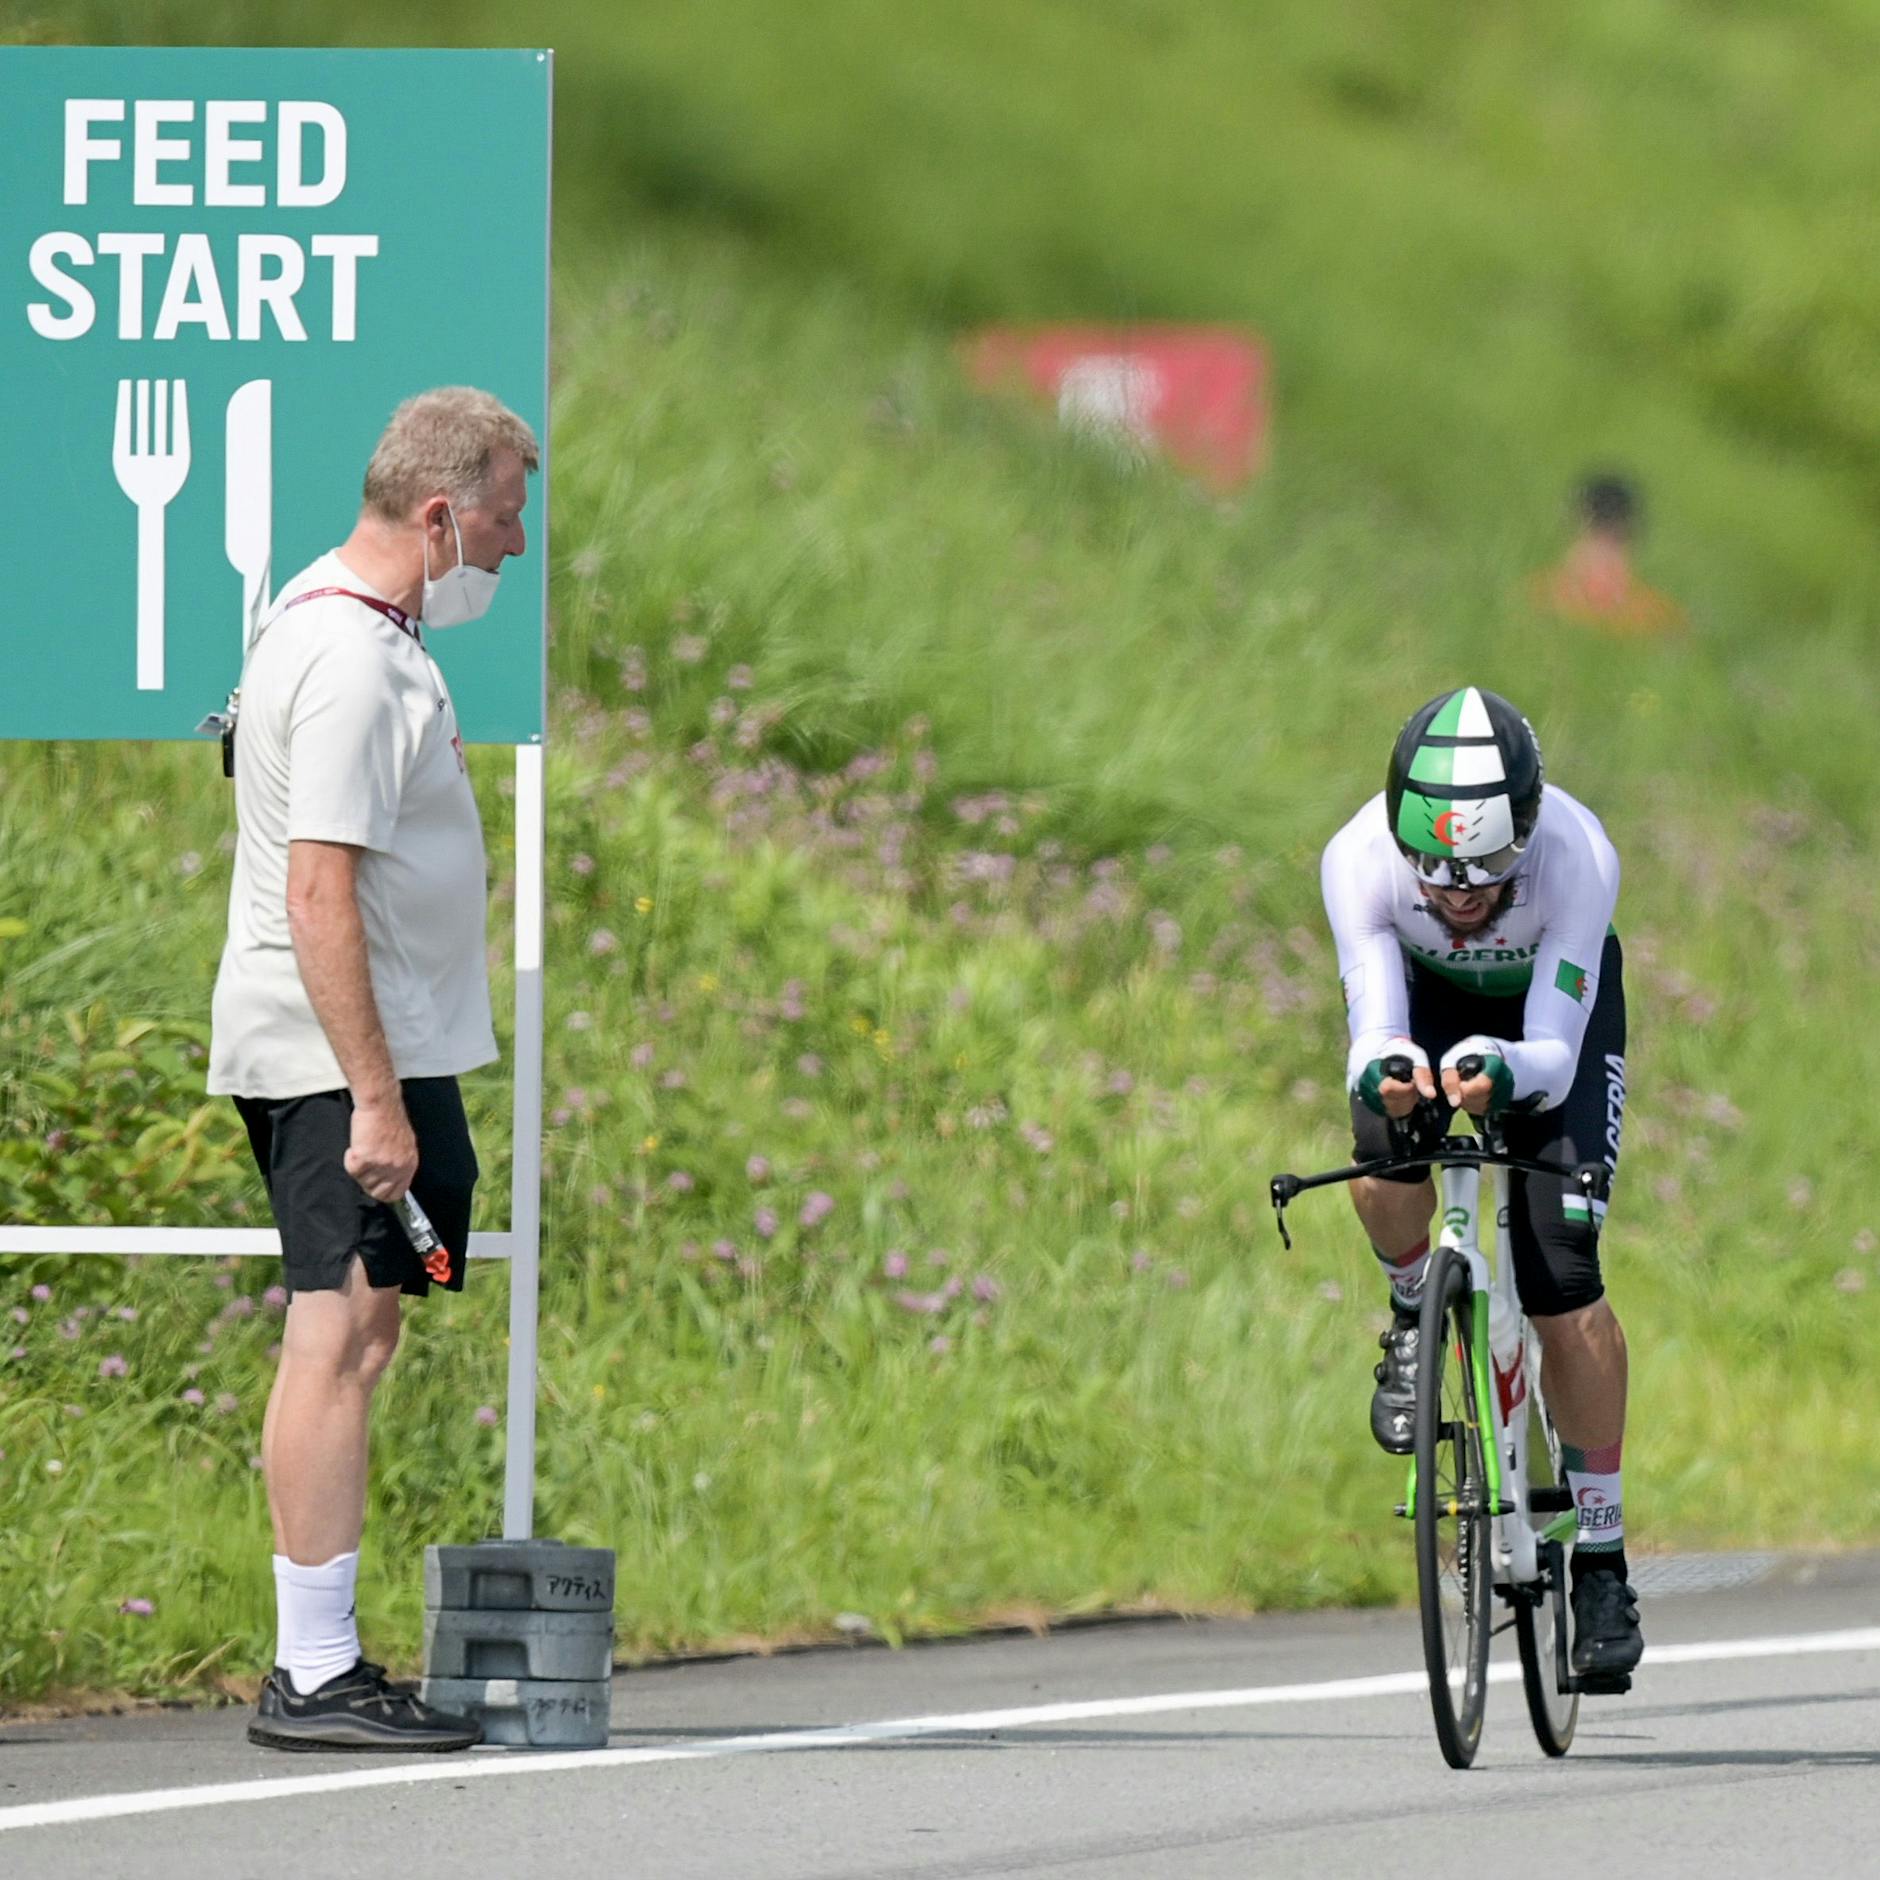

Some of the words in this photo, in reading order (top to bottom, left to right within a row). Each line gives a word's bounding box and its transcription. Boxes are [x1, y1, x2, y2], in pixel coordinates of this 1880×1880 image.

[63, 99, 347, 207] FEED
[27, 231, 379, 341] START
[546, 1574, 607, 1601] アクティス
